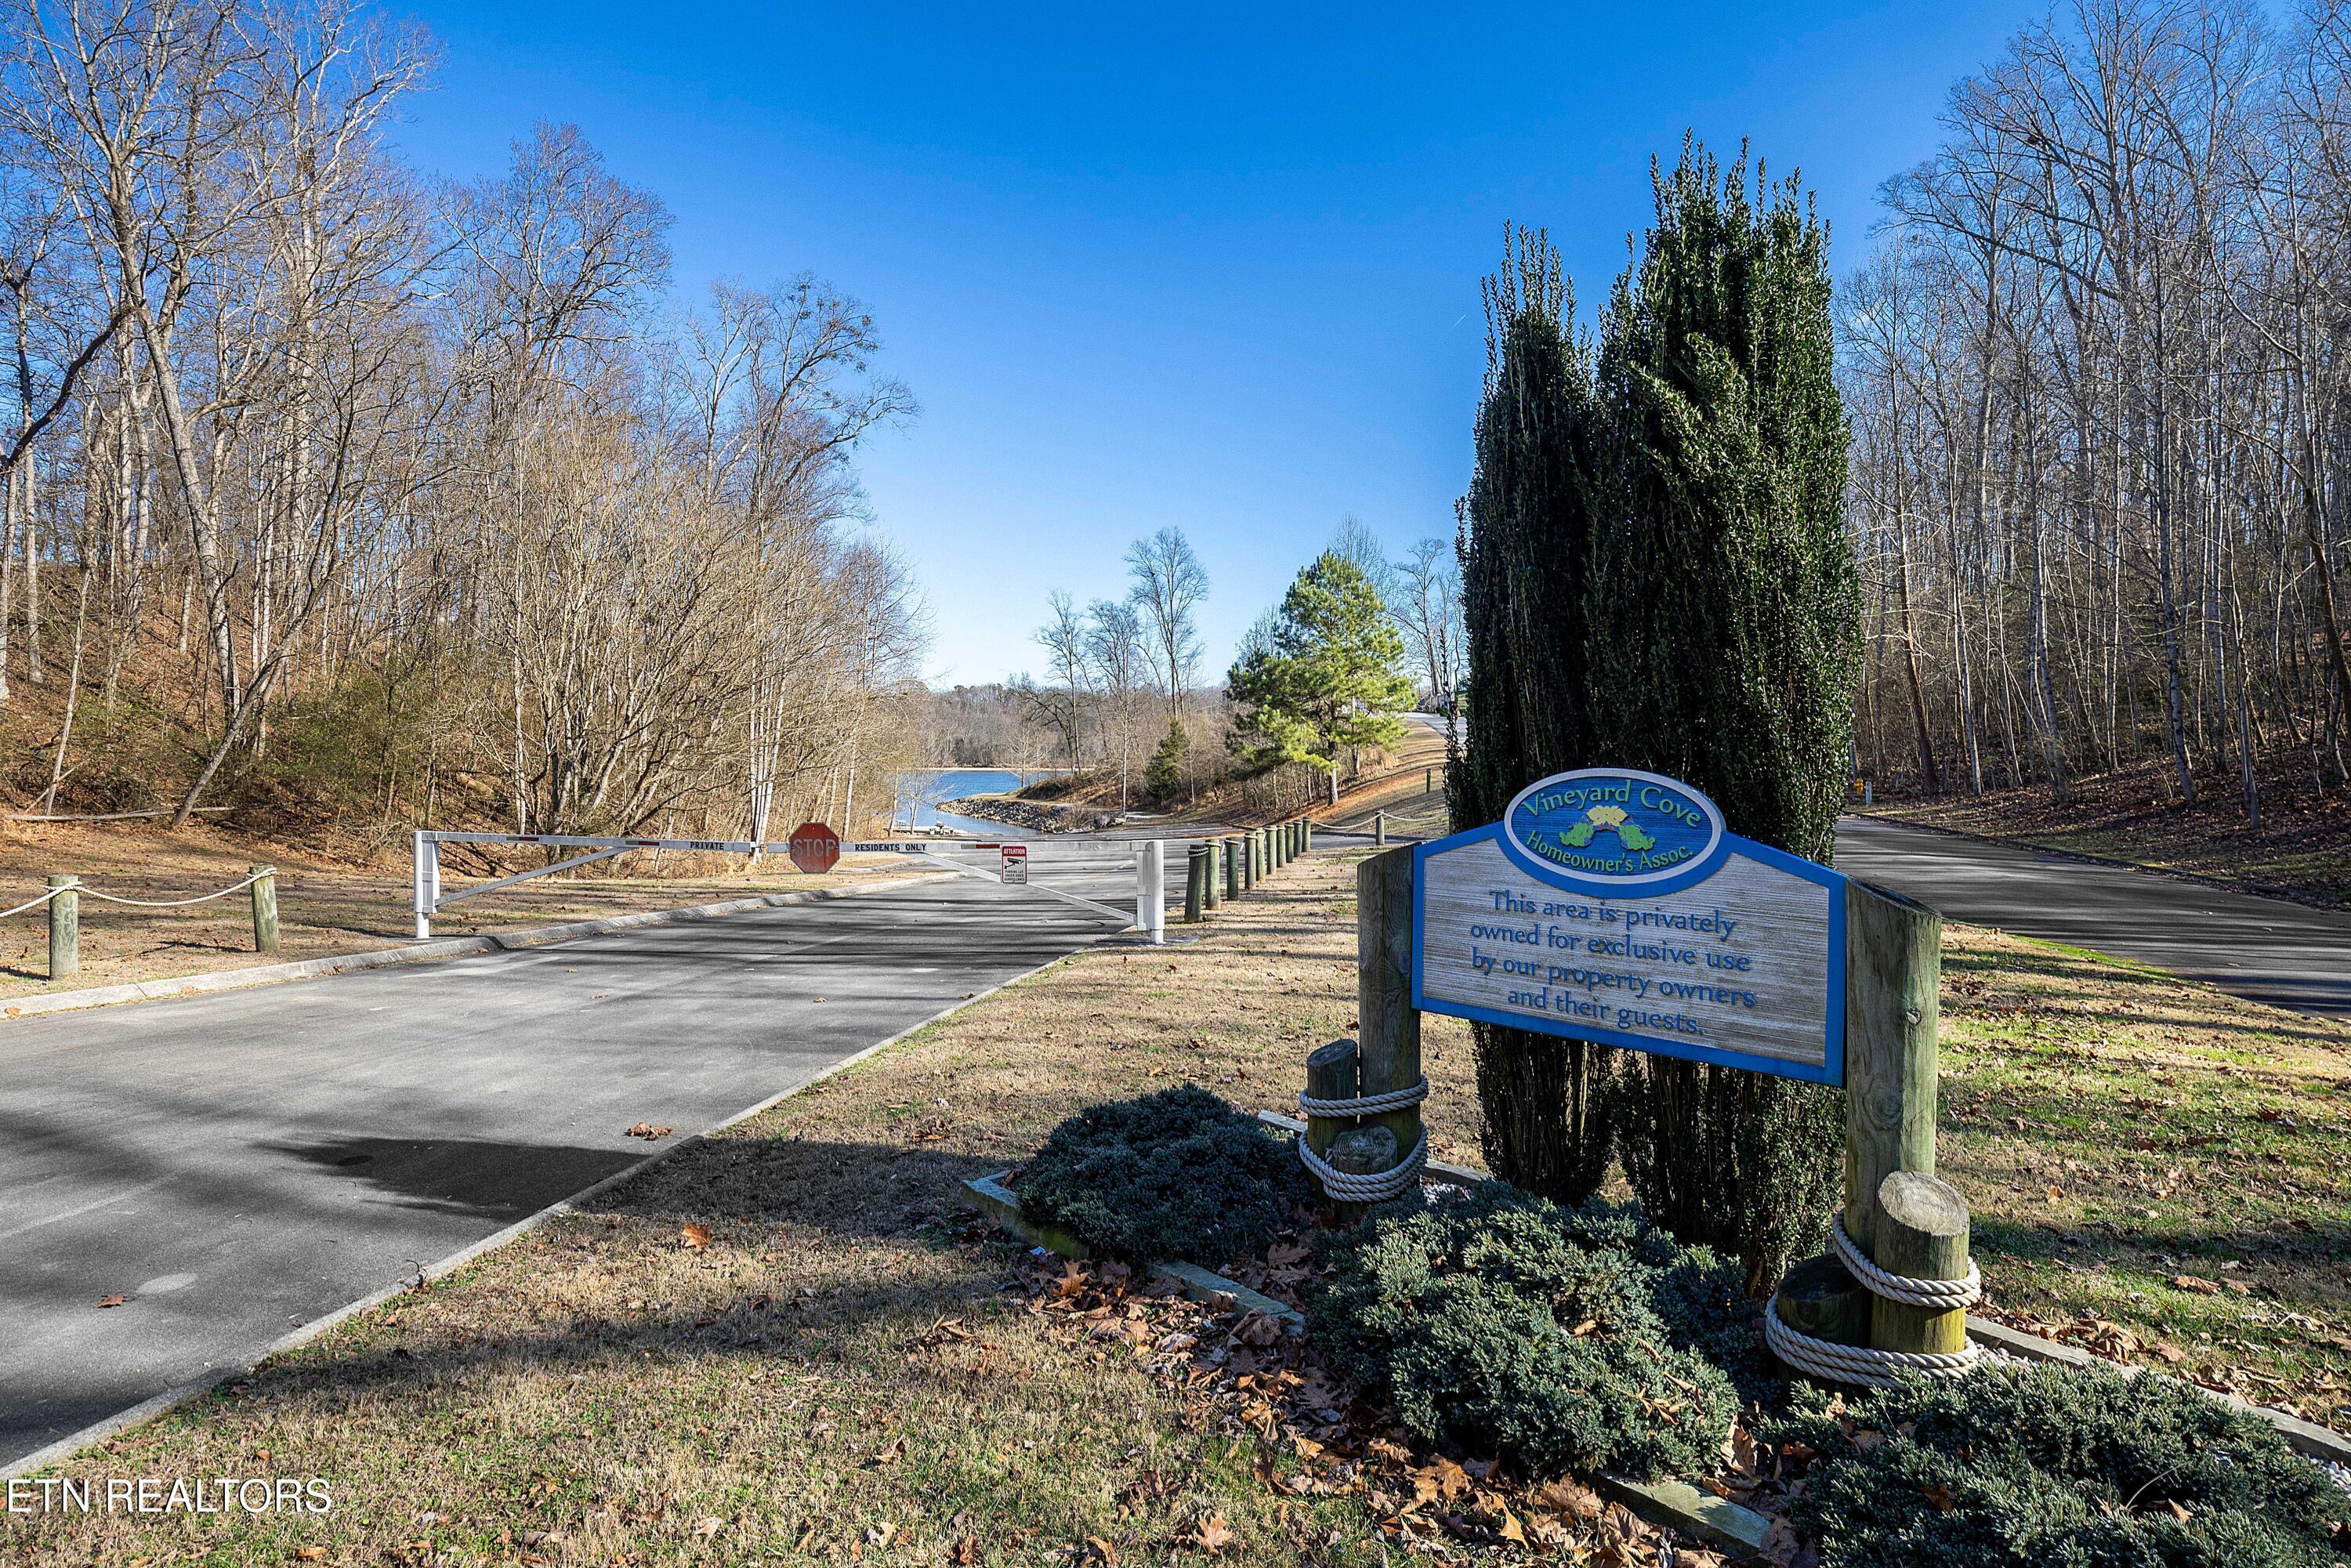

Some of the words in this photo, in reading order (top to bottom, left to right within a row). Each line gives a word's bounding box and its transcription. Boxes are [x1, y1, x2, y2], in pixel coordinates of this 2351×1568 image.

[1522, 780, 1632, 817] Vineyard
[1640, 787, 1701, 827] Cove
[690, 841, 724, 850] PRIVATE
[793, 838, 836, 858] STOP
[855, 844, 900, 852] RESIDENTS
[1527, 831, 1633, 872] Homeowner's
[1639, 846, 1694, 871] Assoc.
[1489, 889, 1536, 913] This
[1542, 902, 1590, 919] area
[1599, 900, 1617, 922] is
[1626, 906, 1737, 941] privately
[1470, 922, 1540, 945] owned
[1548, 924, 1581, 950] for
[1588, 934, 1697, 965] exclusive
[1706, 953, 1751, 971] use
[1472, 946, 1496, 976] by
[1503, 958, 1541, 976] our
[1548, 965, 1650, 998] property
[1659, 980, 1756, 1007] owners
[1508, 985, 1549, 1009] and
[1556, 990, 1610, 1019] their
[1617, 1009, 1705, 1035] guests.
